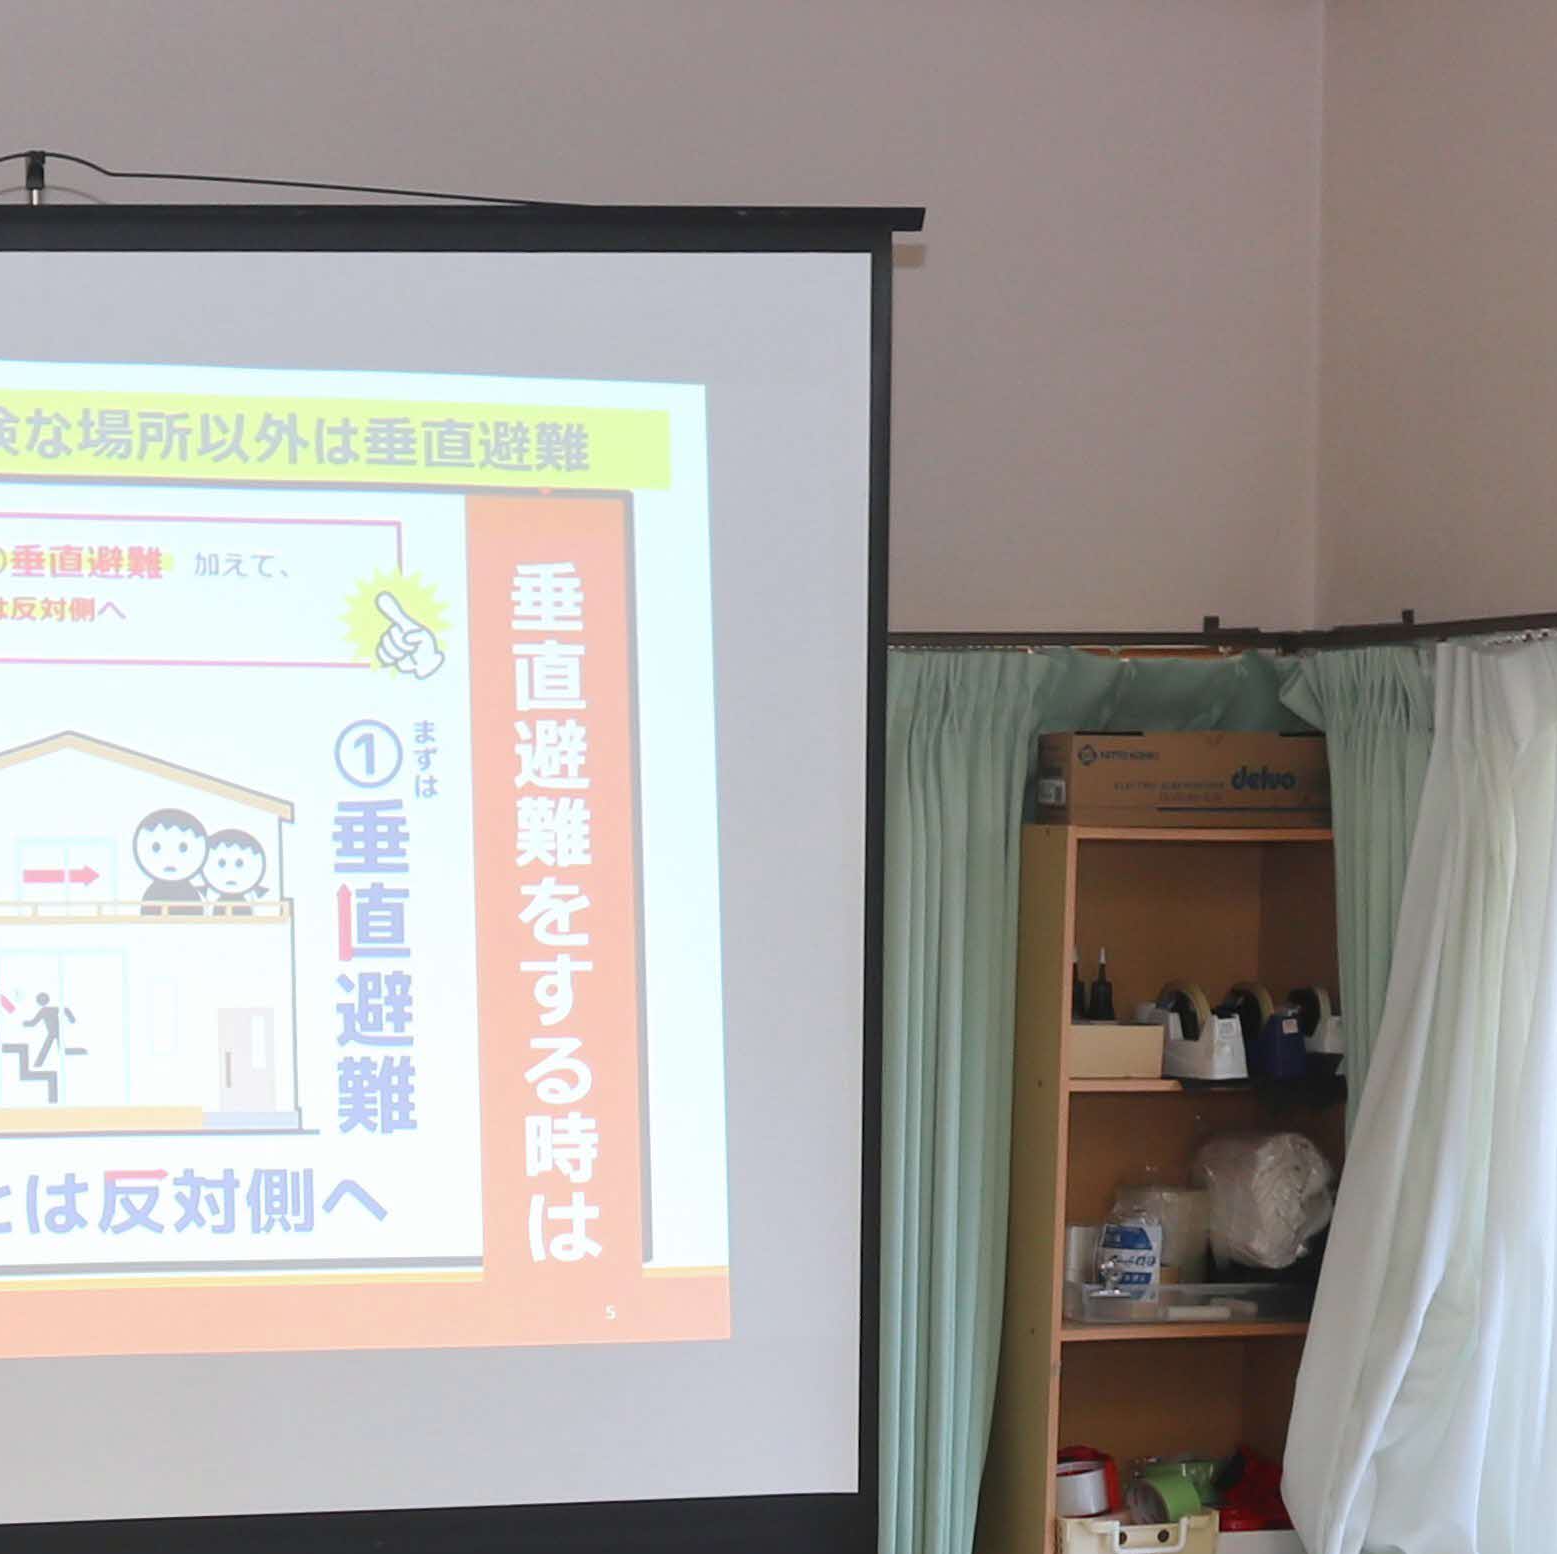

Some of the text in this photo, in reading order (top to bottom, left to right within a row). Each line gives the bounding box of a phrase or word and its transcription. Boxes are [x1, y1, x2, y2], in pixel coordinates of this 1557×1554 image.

[194, 551, 291, 579] 加えて、
[413, 719, 439, 799] まずは
[510, 561, 603, 1263] 垂直避難をする時は
[605, 1304, 616, 1320] 5
